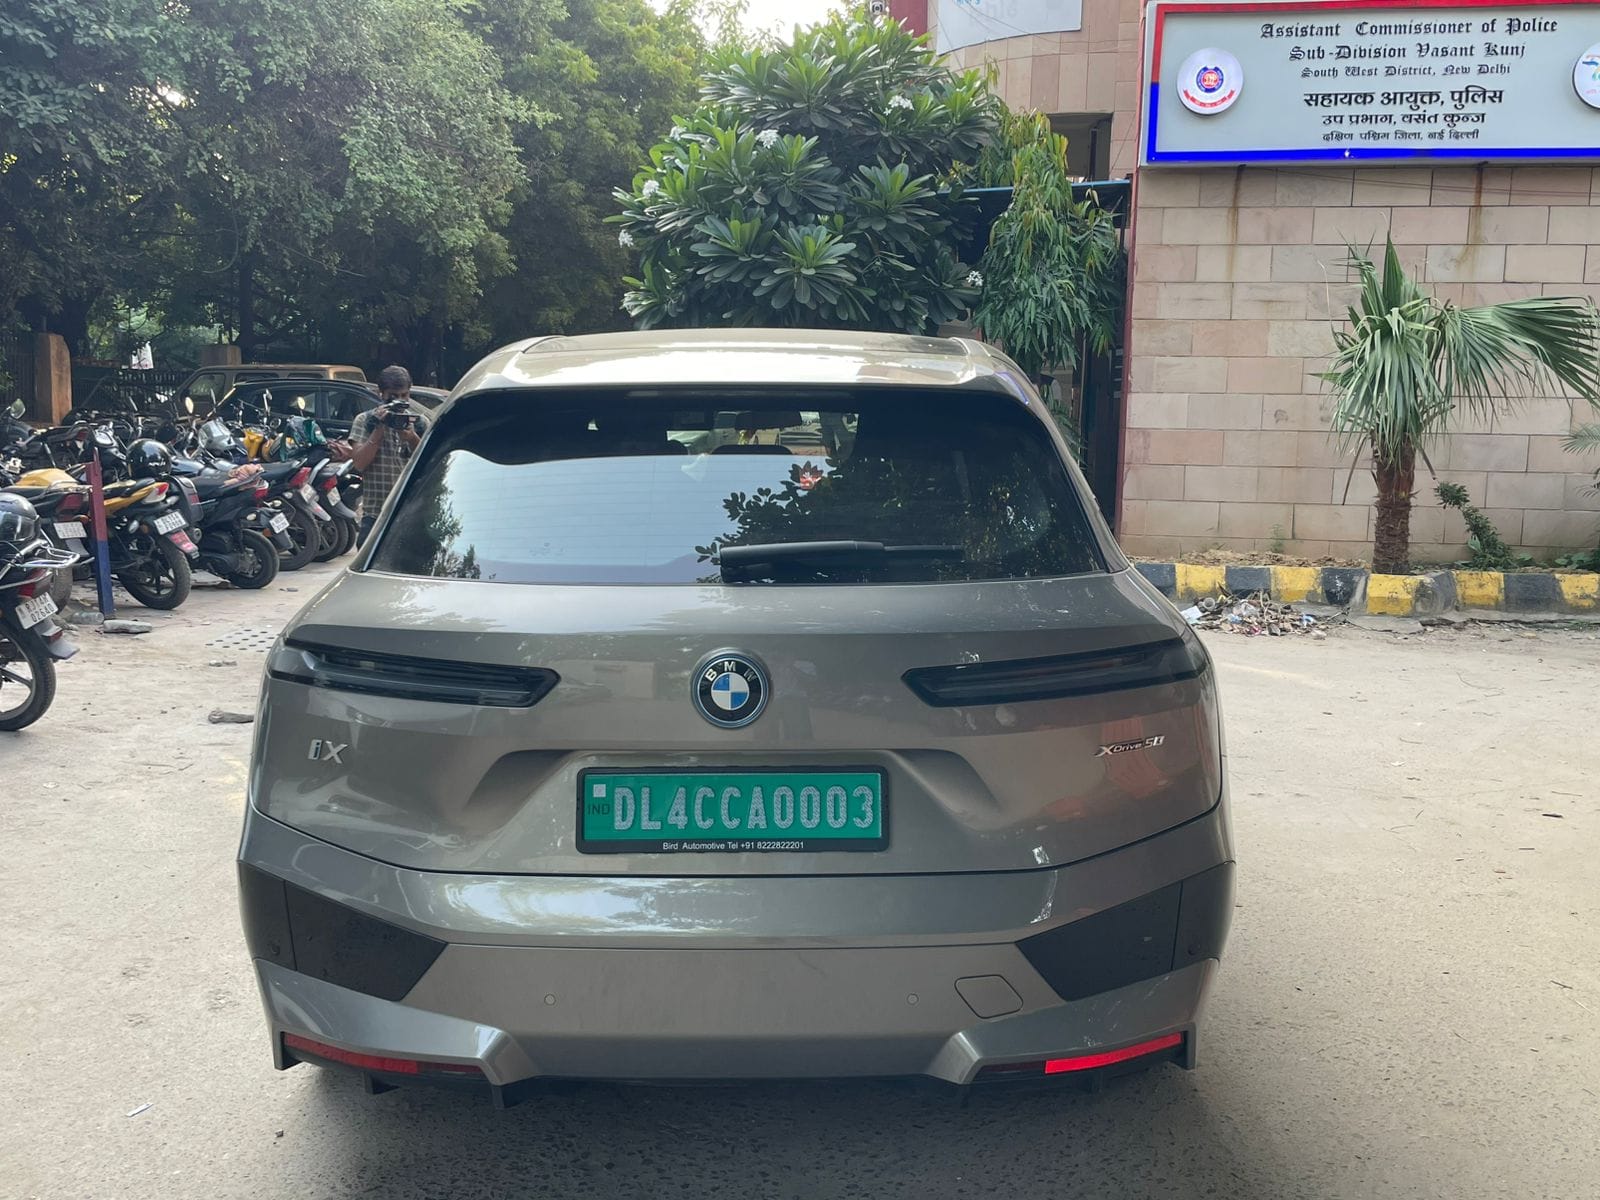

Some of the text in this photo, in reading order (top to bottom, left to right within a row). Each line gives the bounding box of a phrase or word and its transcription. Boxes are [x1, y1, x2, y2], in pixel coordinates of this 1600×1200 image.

[1260, 17, 1558, 39] Assistant Commissioner of Police
[1416, 42, 1475, 58] Vasant
[1484, 42, 1526, 58] Kunj
[1301, 63, 1511, 78] South West District, New Delhi
[1303, 85, 1505, 111] सहायक आयुक्त, पुलिस
[1321, 114, 1344, 126] उप
[1400, 110, 1439, 124] वसंत
[1442, 112, 1487, 128] कुन्ज
[1321, 130, 1354, 142] दक्षिण
[1448, 128, 1480, 140] दिल्ली
[705, 661, 757, 682] BMW
[587, 803, 611, 815] IND
[614, 785, 874, 830] DL4CCA0003
[662, 841, 678, 850] Bird
[682, 841, 725, 850] Automotive
[727, 841, 739, 850] Tel
[740, 841, 754, 850] +91
